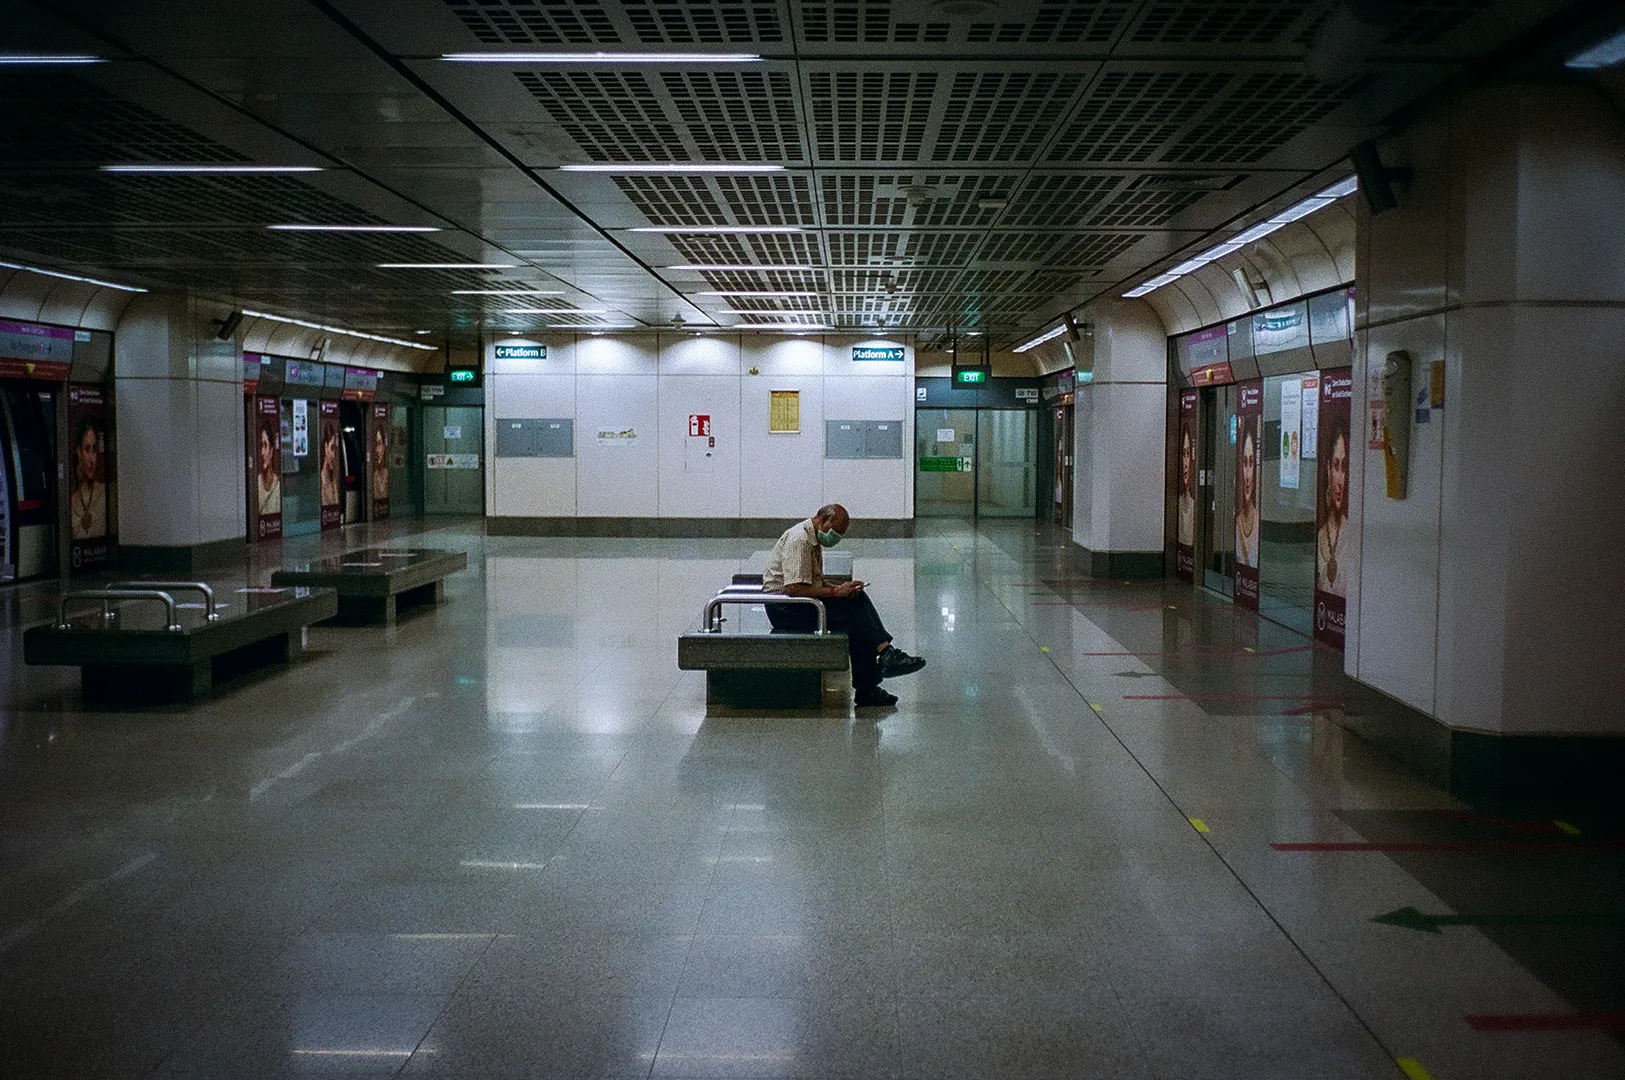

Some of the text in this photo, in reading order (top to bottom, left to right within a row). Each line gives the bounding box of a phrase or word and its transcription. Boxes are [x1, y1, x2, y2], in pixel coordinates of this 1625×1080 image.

[505, 347, 546, 357] Platform B
[853, 349, 894, 358] Platform A
[451, 371, 465, 381] EXIT
[964, 373, 979, 382] EXIT
